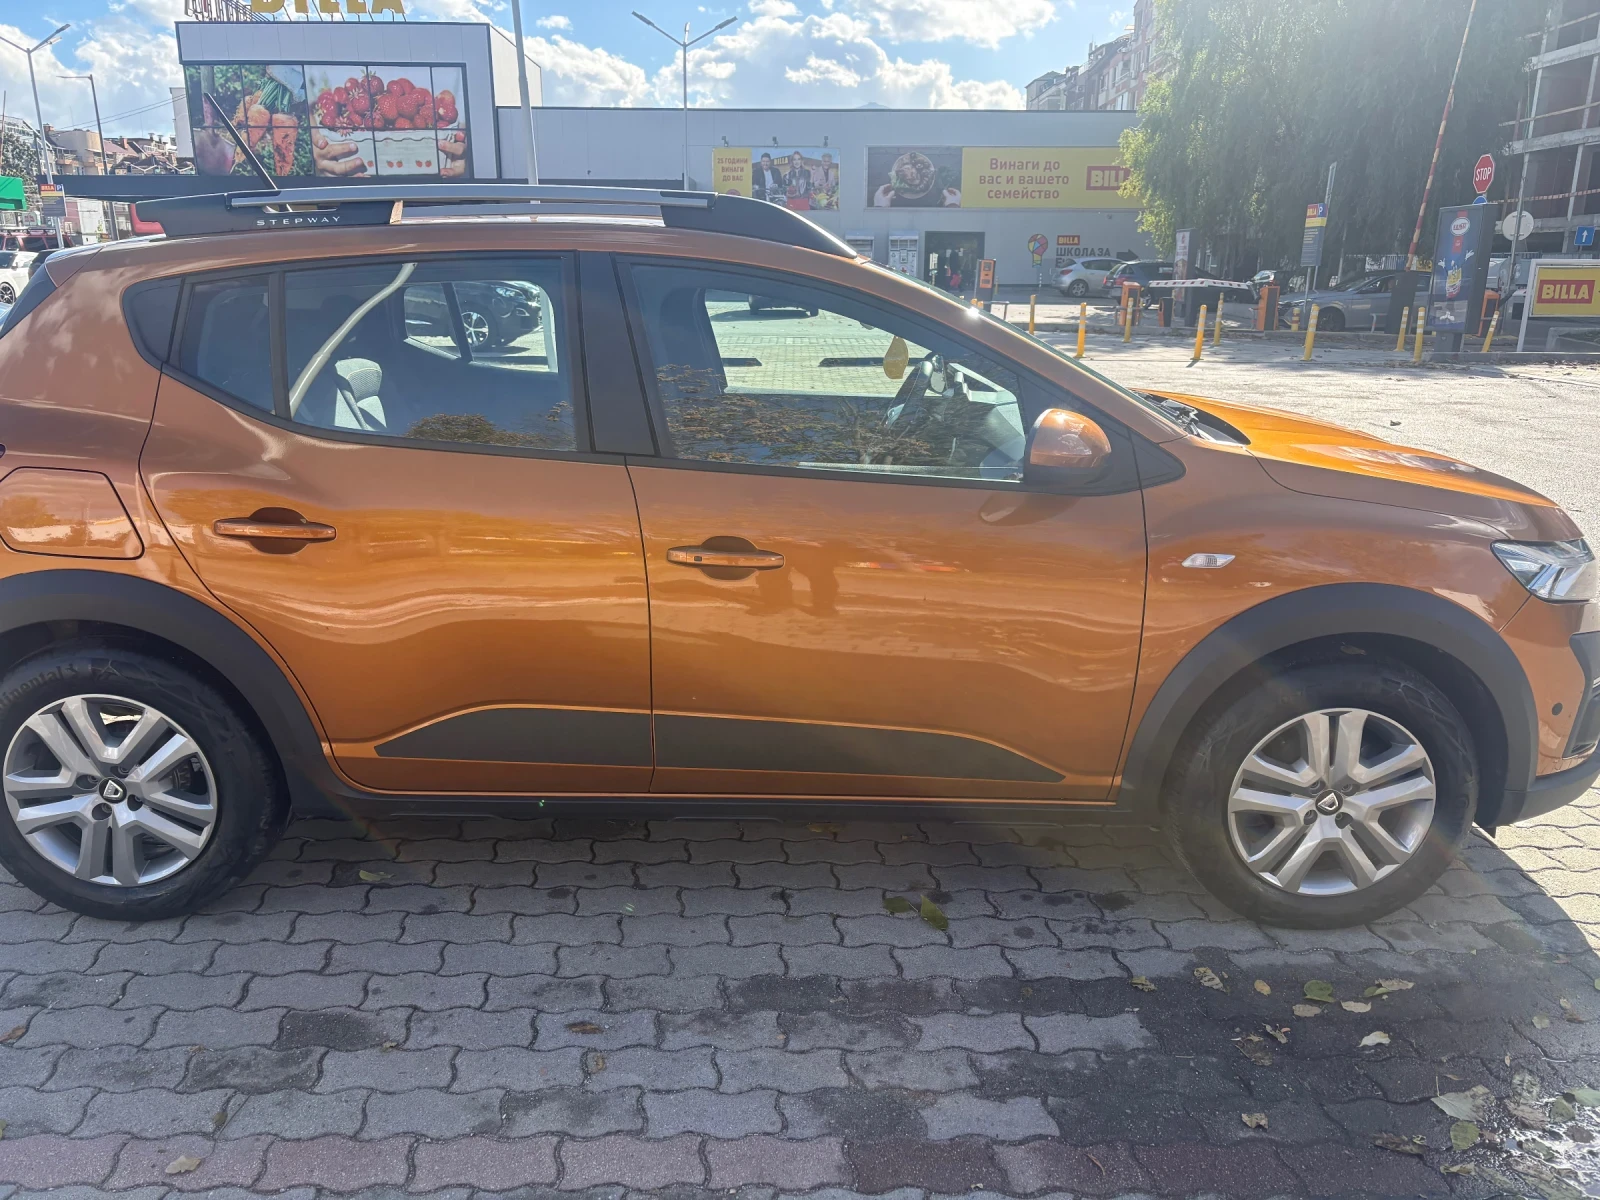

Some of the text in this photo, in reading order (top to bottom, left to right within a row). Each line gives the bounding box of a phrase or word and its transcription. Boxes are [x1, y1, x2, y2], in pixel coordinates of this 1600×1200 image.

[724, 157, 748, 165] ГОДИНИ
[989, 158, 1060, 173] Винаги до
[732, 174, 744, 182] ВАС
[979, 174, 1069, 185] вас и вашето
[1090, 170, 1126, 187] BILL
[1475, 166, 1492, 182] STOP
[987, 187, 1060, 200] семейство
[256, 216, 340, 226] STEPWAY
[1058, 236, 1079, 244] BILLA
[1541, 284, 1589, 300] BILLA
